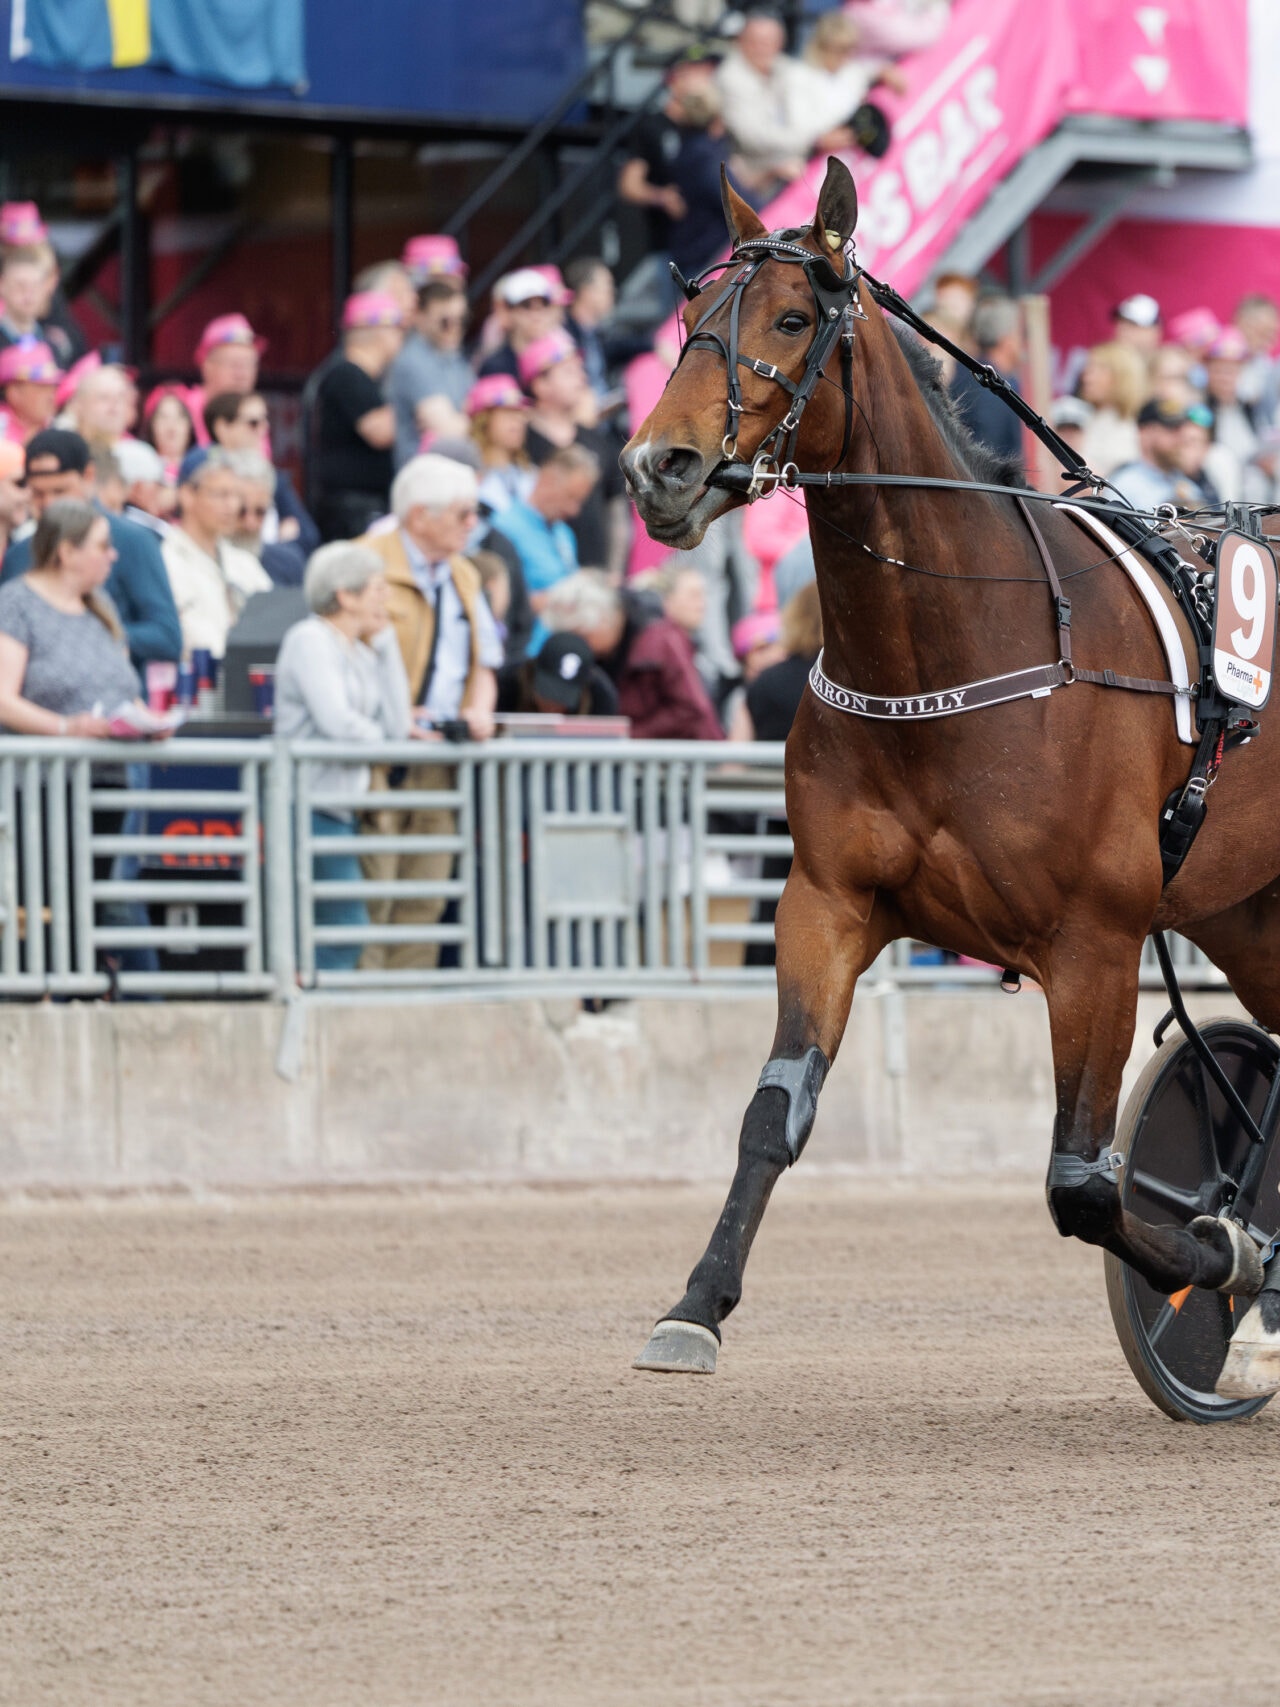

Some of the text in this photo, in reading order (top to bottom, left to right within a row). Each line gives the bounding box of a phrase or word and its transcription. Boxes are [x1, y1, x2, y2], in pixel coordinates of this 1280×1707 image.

[1231, 544, 1266, 659] 9
[813, 673, 967, 715] BARON TILLY
